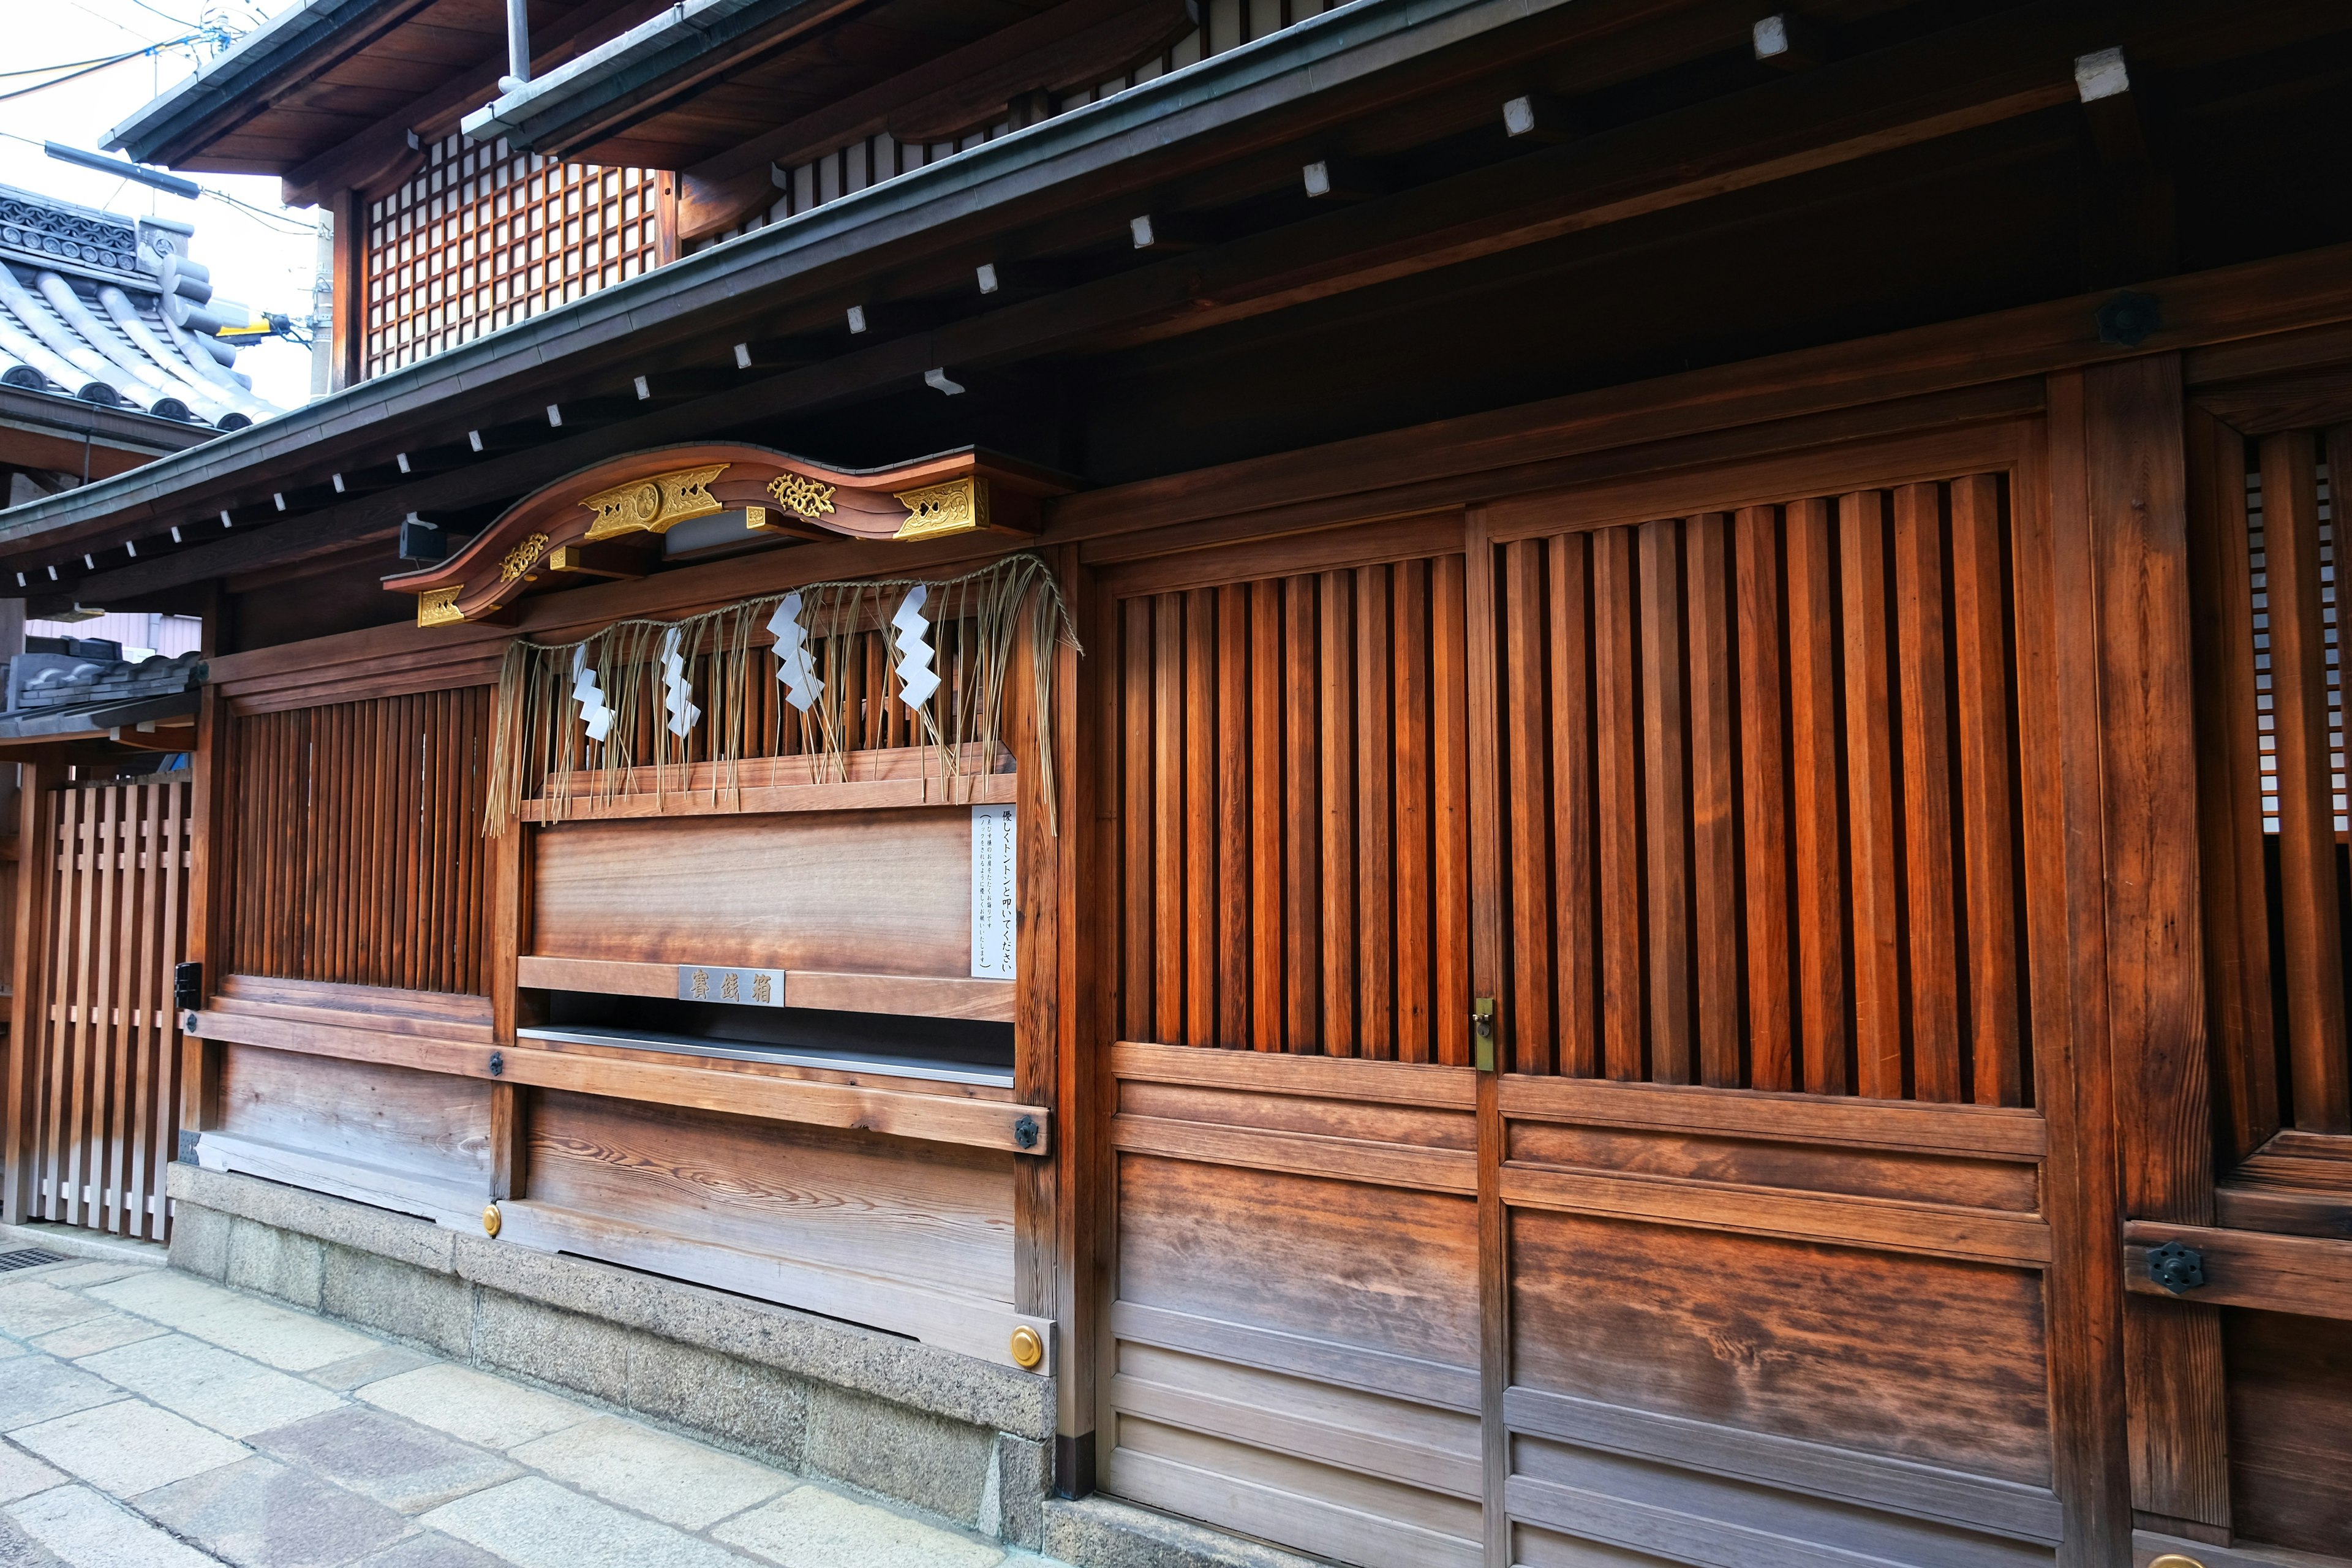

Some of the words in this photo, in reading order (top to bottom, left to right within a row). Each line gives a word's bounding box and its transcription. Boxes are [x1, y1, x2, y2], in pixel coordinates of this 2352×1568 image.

[1002, 810, 1012, 972] 優しくトントンと叩いてください
[690, 969, 771, 1003] 賽銭箱
